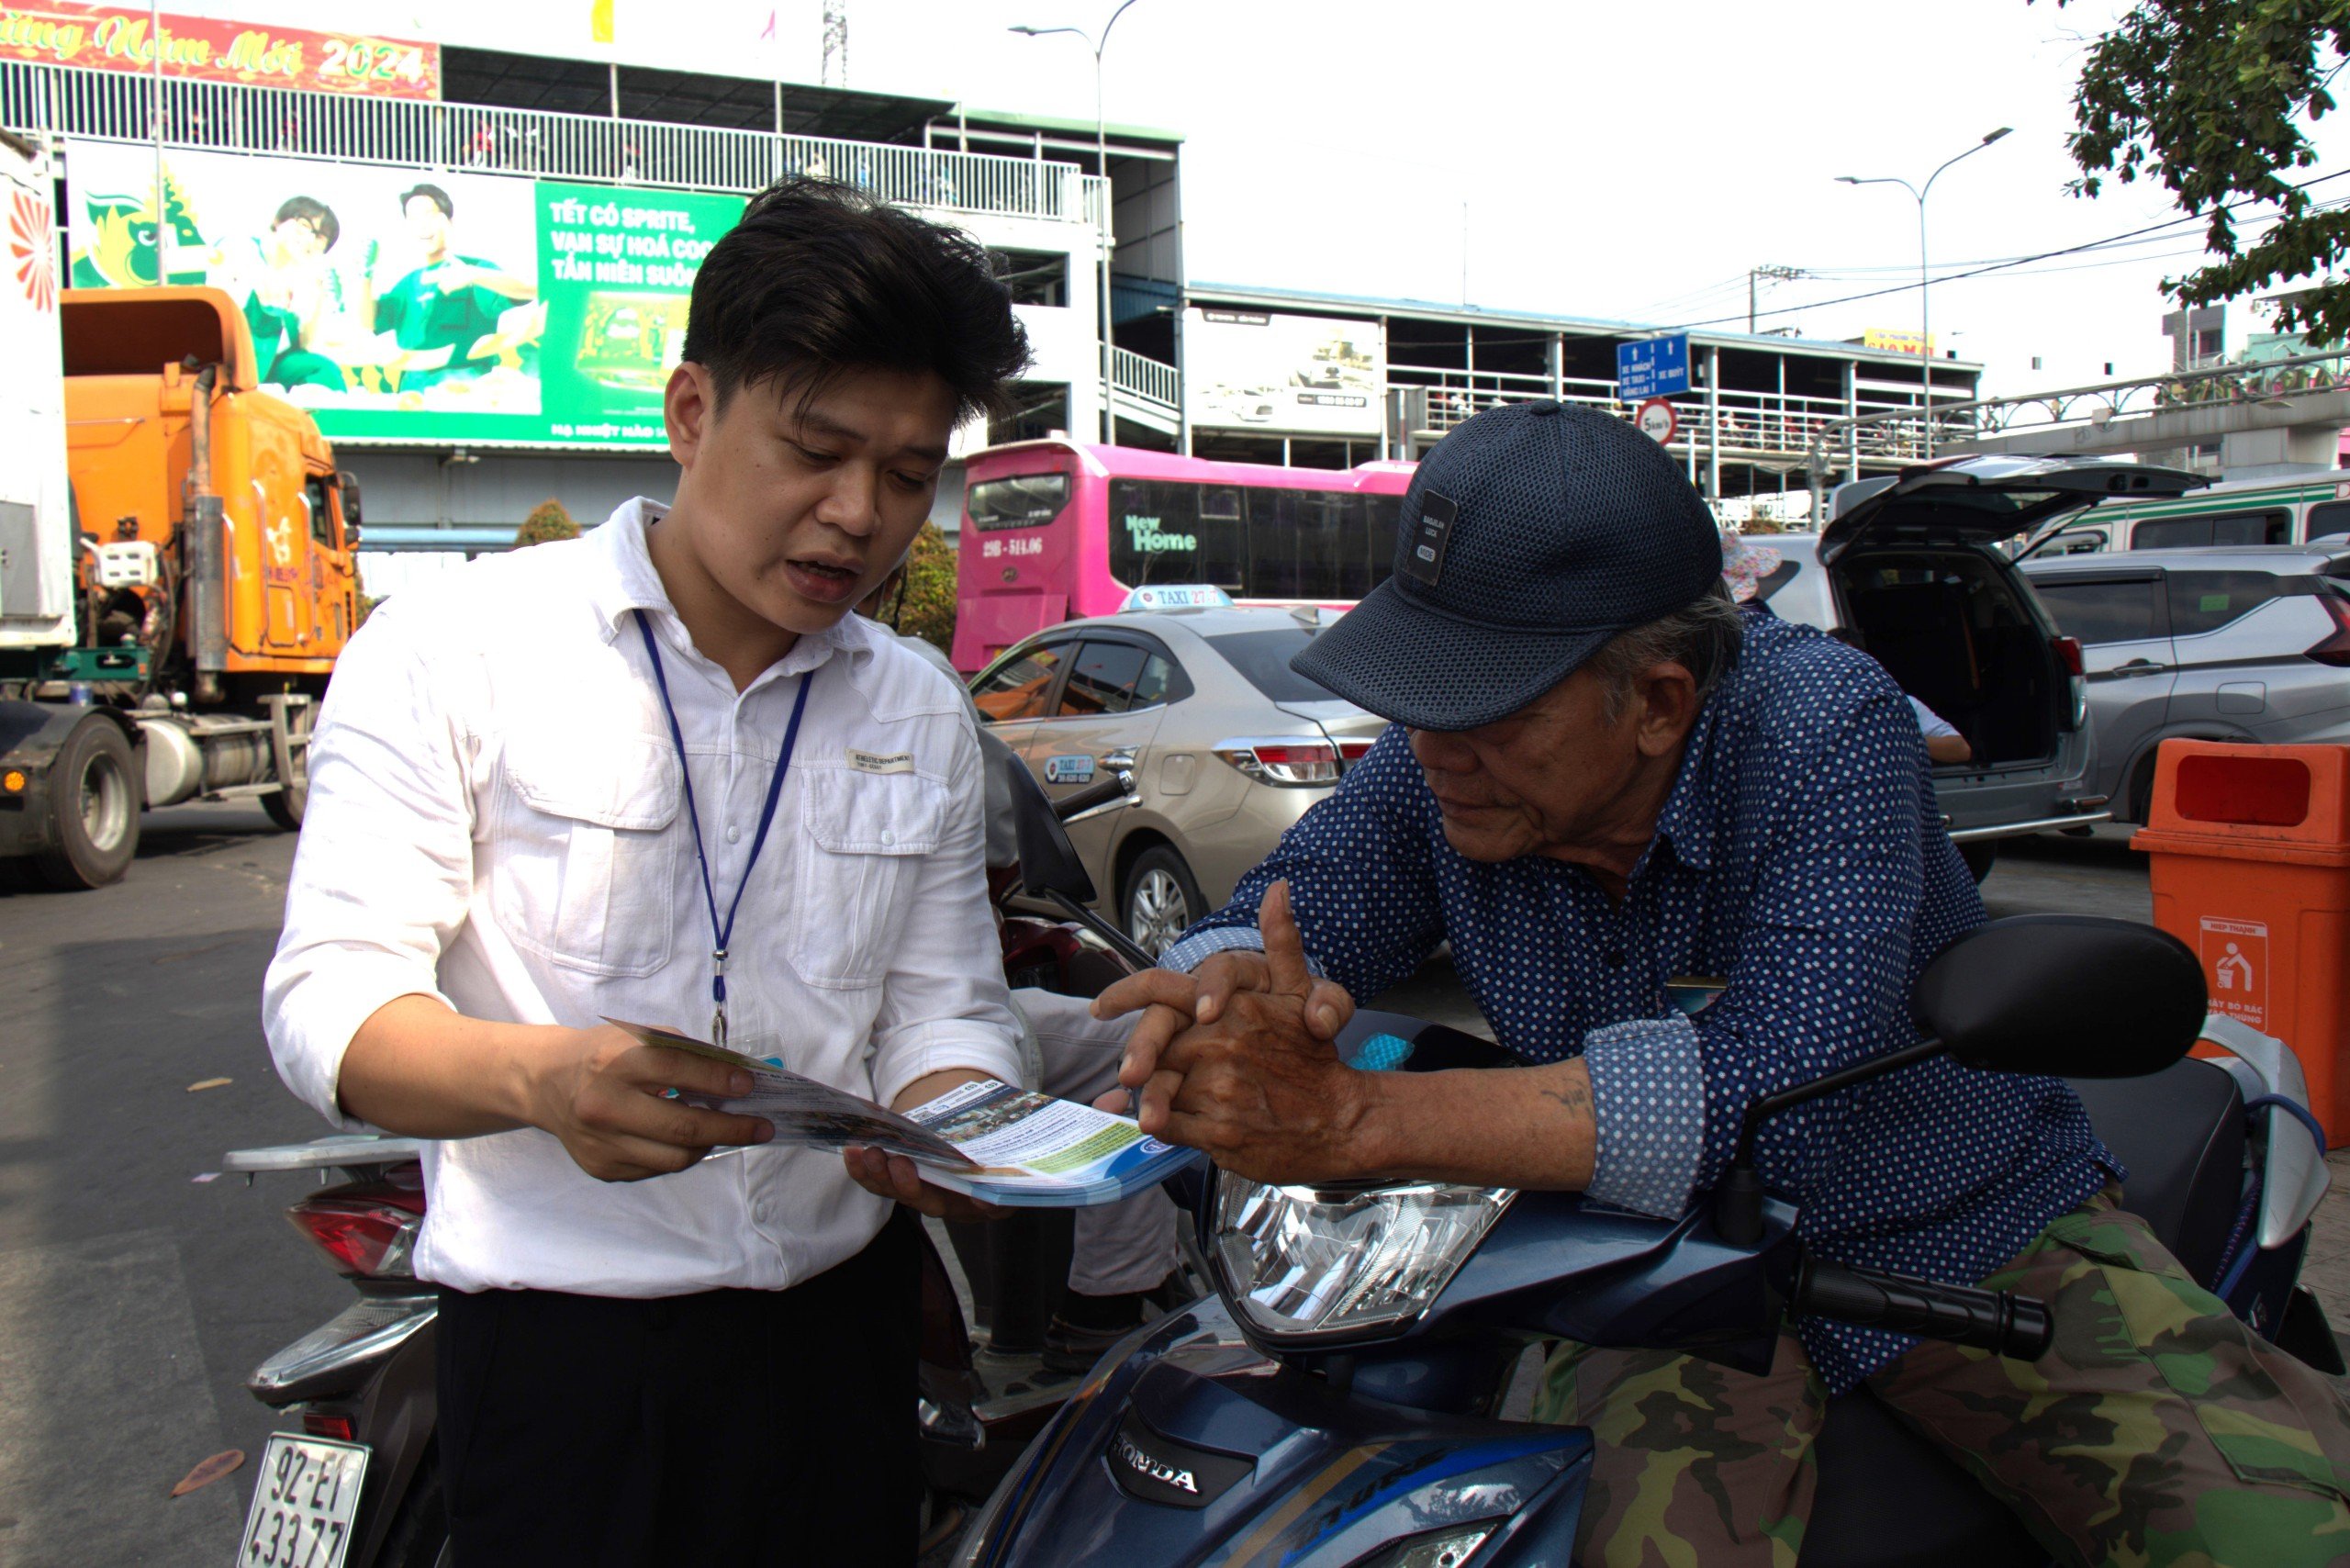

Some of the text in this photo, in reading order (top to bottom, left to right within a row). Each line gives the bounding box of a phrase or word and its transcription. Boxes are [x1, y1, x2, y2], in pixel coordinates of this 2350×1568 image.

[94, 14, 210, 65] Năm
[215, 30, 304, 76] Mới
[319, 39, 424, 84] 2024
[550, 197, 696, 234] TẾT CÓ SPRITE,
[595, 232, 626, 259] SỰ
[627, 233, 671, 258] HOÁ
[595, 259, 643, 285] NIÊN
[1125, 515, 1161, 531] New
[1133, 529, 1197, 552] Home
[1158, 590, 1189, 604] TAXI
